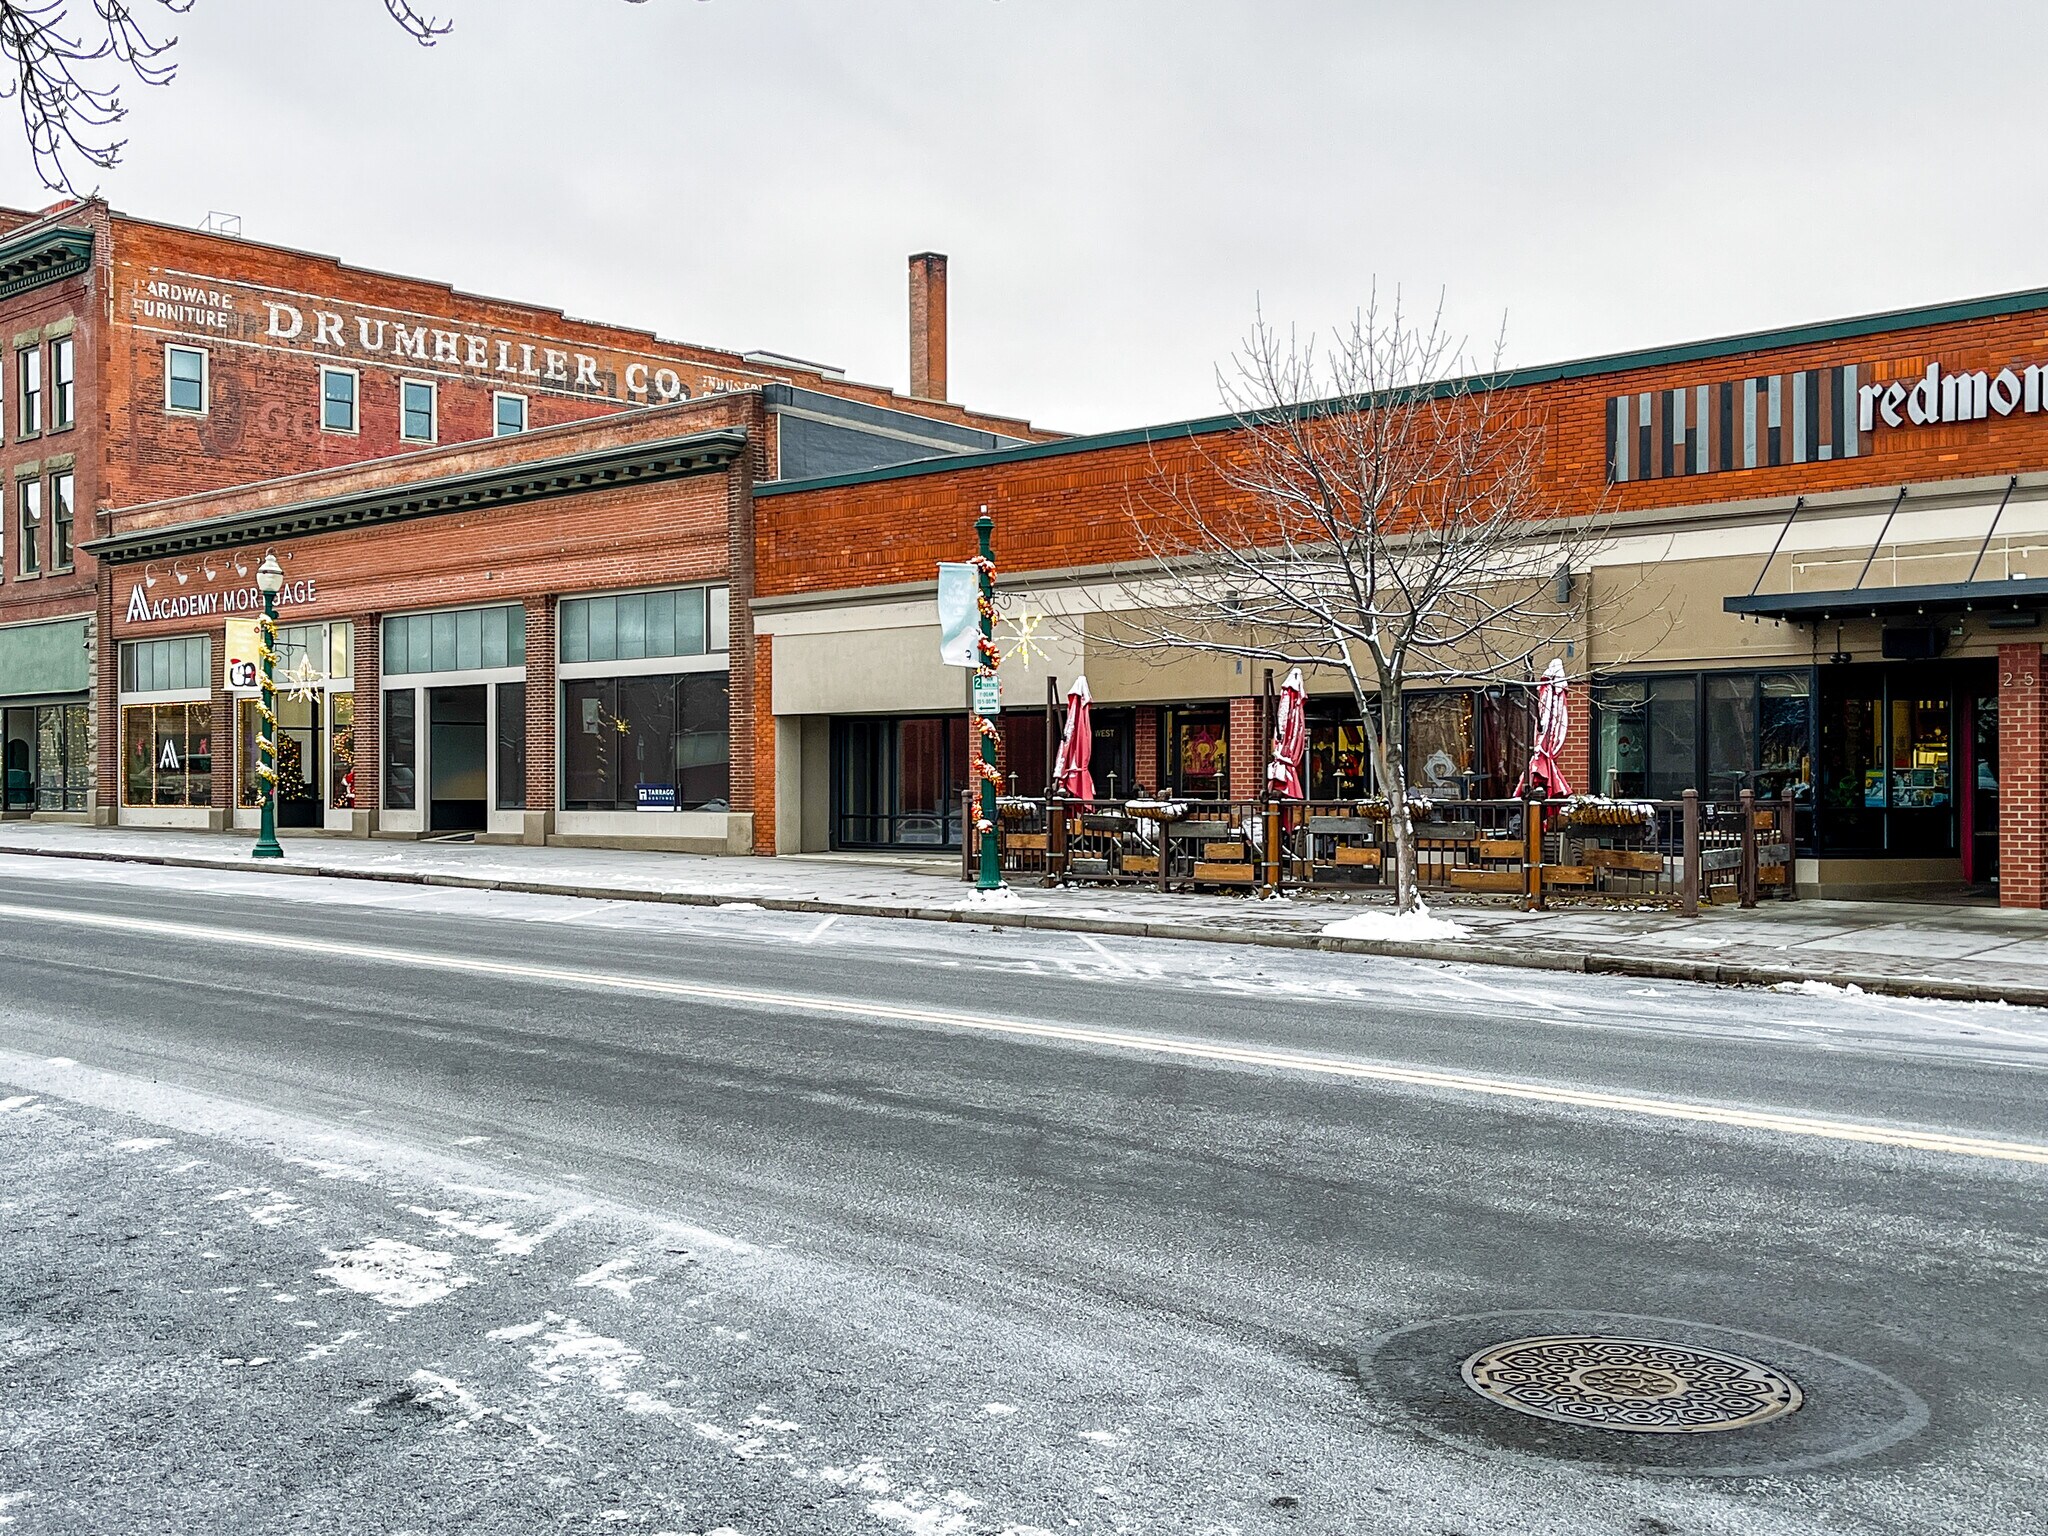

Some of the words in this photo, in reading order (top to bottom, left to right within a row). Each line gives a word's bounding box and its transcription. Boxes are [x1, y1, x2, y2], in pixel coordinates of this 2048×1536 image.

[261, 300, 602, 388] DRUMHELLER
[152, 593, 219, 620] ACADEMY
[975, 677, 982, 689] 2
